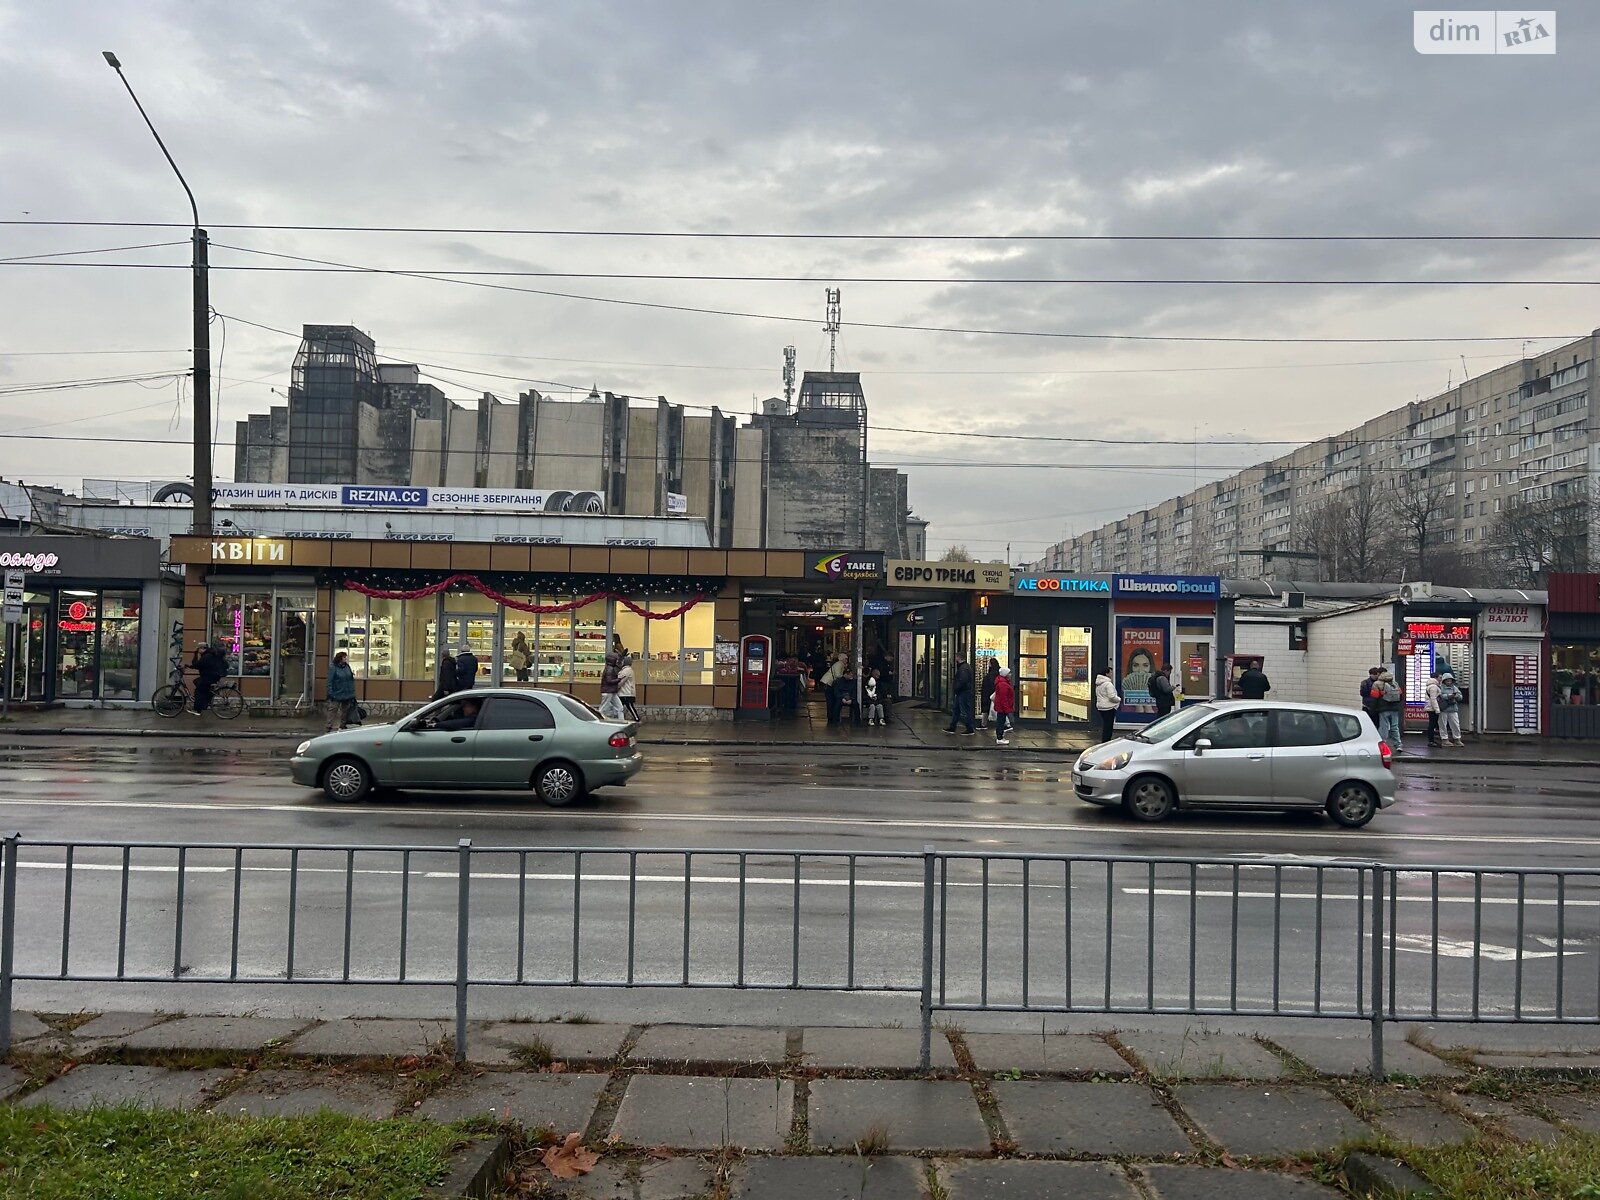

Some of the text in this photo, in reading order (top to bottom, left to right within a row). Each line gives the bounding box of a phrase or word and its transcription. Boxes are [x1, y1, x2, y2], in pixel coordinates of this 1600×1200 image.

[257, 490, 281, 498] ШИН
[285, 490, 297, 499] ТА
[300, 491, 338, 500] ДИСКІВ
[349, 489, 421, 503] REZINA.CC
[432, 493, 542, 504] СЕЗОННЕ ЗБЕРІГАННЯ
[212, 542, 284, 560] КВІТИ
[0, 553, 58, 572] оянда
[847, 562, 876, 570] ТАКЕ!
[895, 566, 976, 584] ЄВРО ТРЕНД
[1119, 579, 1216, 593] ШвидкоГроші
[1488, 607, 1529, 615] ОБМІН
[1124, 631, 1161, 640] ГРОШІ
